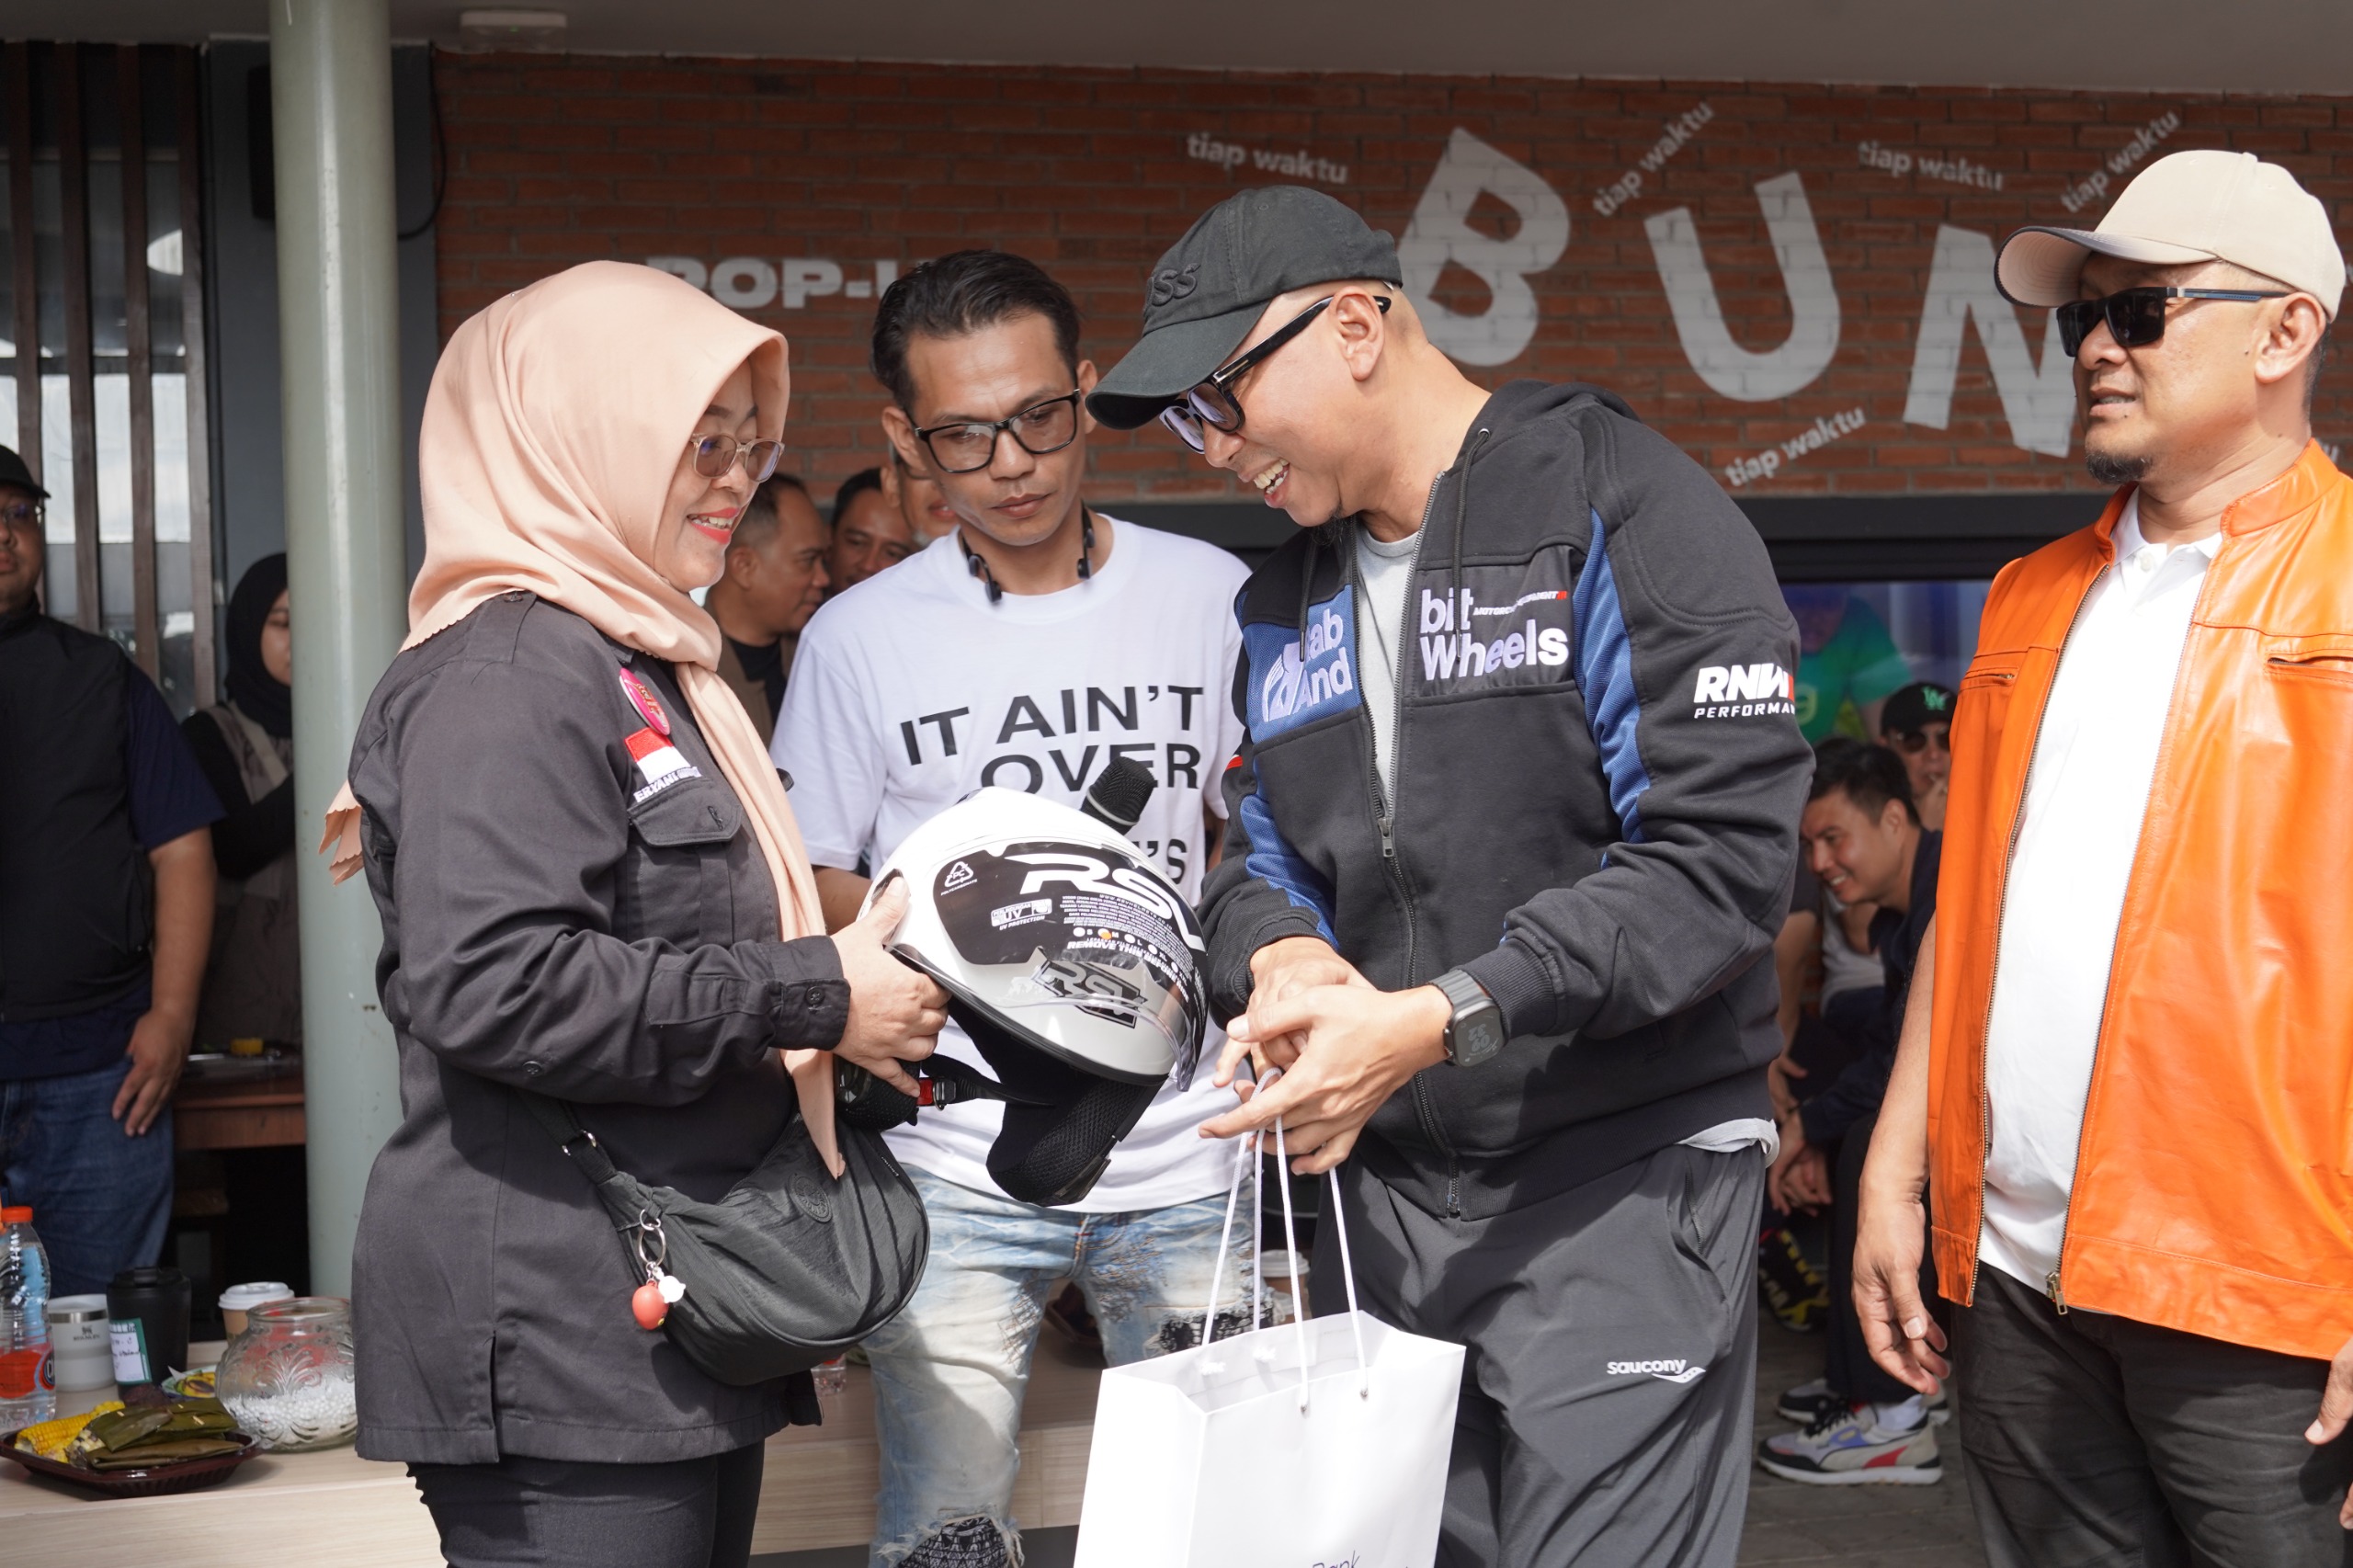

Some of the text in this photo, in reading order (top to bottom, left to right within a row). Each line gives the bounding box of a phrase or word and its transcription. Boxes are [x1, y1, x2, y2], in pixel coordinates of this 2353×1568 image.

[1188, 131, 1347, 184] tiap waktu
[1593, 102, 1714, 216] tiap waktu
[1859, 141, 2003, 191] tiap waktu
[2061, 111, 2179, 213] tiap waktu
[1725, 407, 1865, 487] tiap waktu
[1305, 608, 1344, 660] ab
[1420, 587, 1473, 634] bit
[1419, 619, 1569, 681] Wheels
[1291, 647, 1353, 716] And
[900, 685, 1204, 767] IT AIN'T
[633, 771, 679, 803] ERYANI
[998, 915, 1045, 931] UV PROTECTION
[1067, 940, 1117, 949] REMOVE
[1607, 1358, 1687, 1375] saucony
